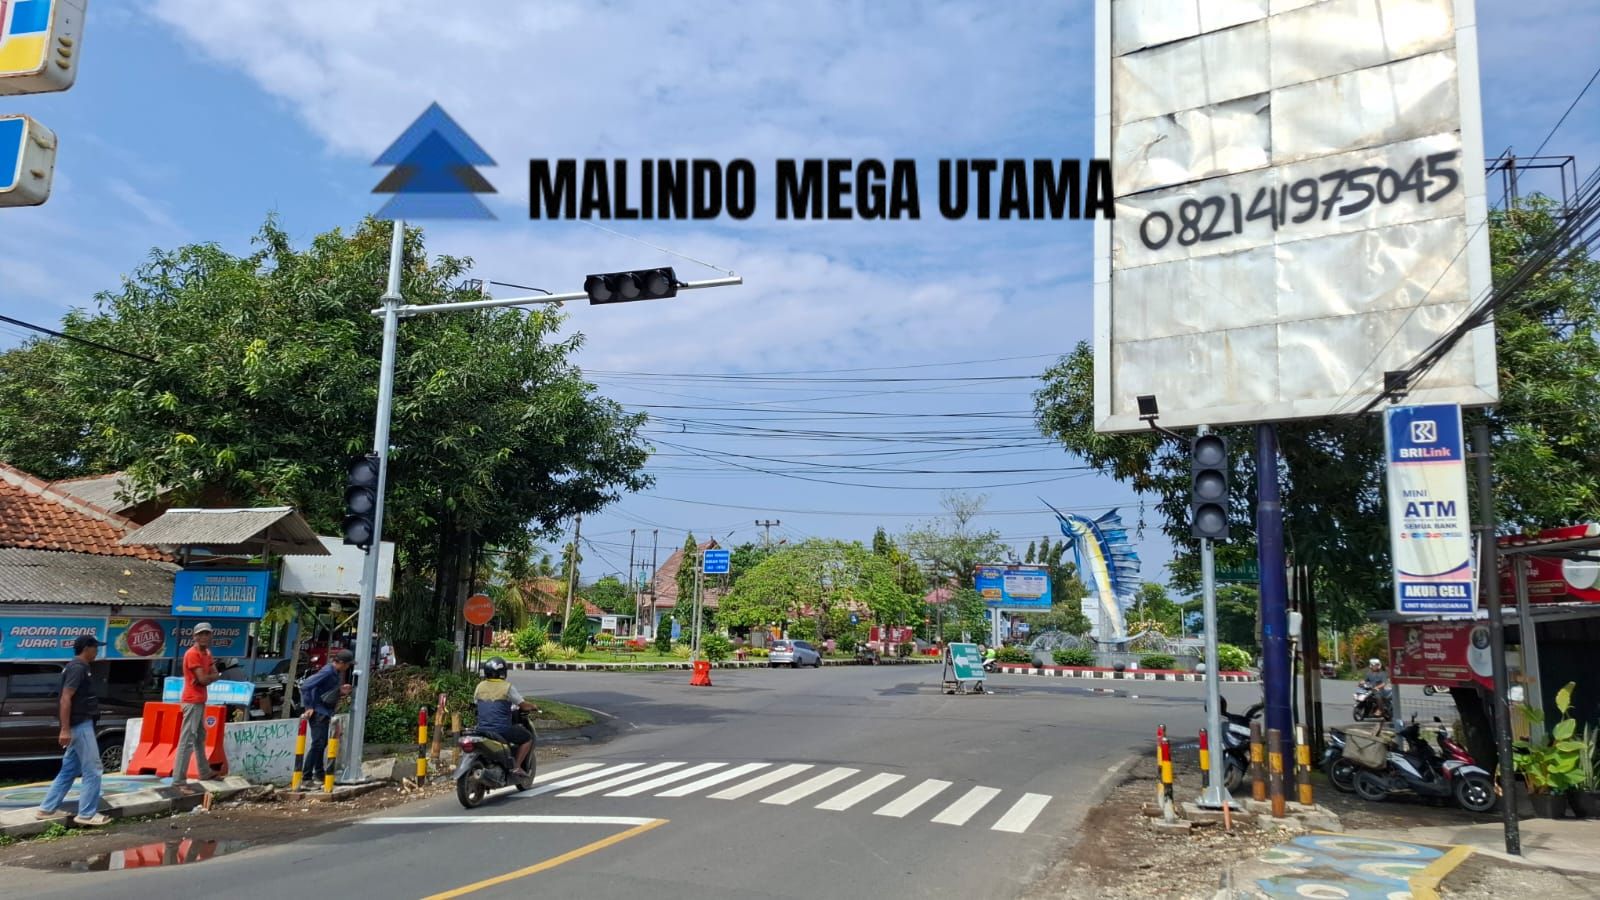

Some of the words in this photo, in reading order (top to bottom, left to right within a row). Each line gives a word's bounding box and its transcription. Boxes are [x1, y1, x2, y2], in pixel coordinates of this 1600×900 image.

[1140, 151, 1462, 250] 082141975045
[1400, 447, 1451, 458] BRILink
[1403, 489, 1428, 497] MINI
[1405, 500, 1457, 518] ATM
[192, 586, 220, 601] KARYA
[223, 586, 257, 602] BAHARI
[1405, 585, 1438, 598] AKUR
[1439, 585, 1467, 598] CELL
[10, 626, 57, 636] AROMA
[59, 627, 96, 636] MANIS
[17, 639, 57, 648] JUARA
[133, 631, 160, 645] JUARA
